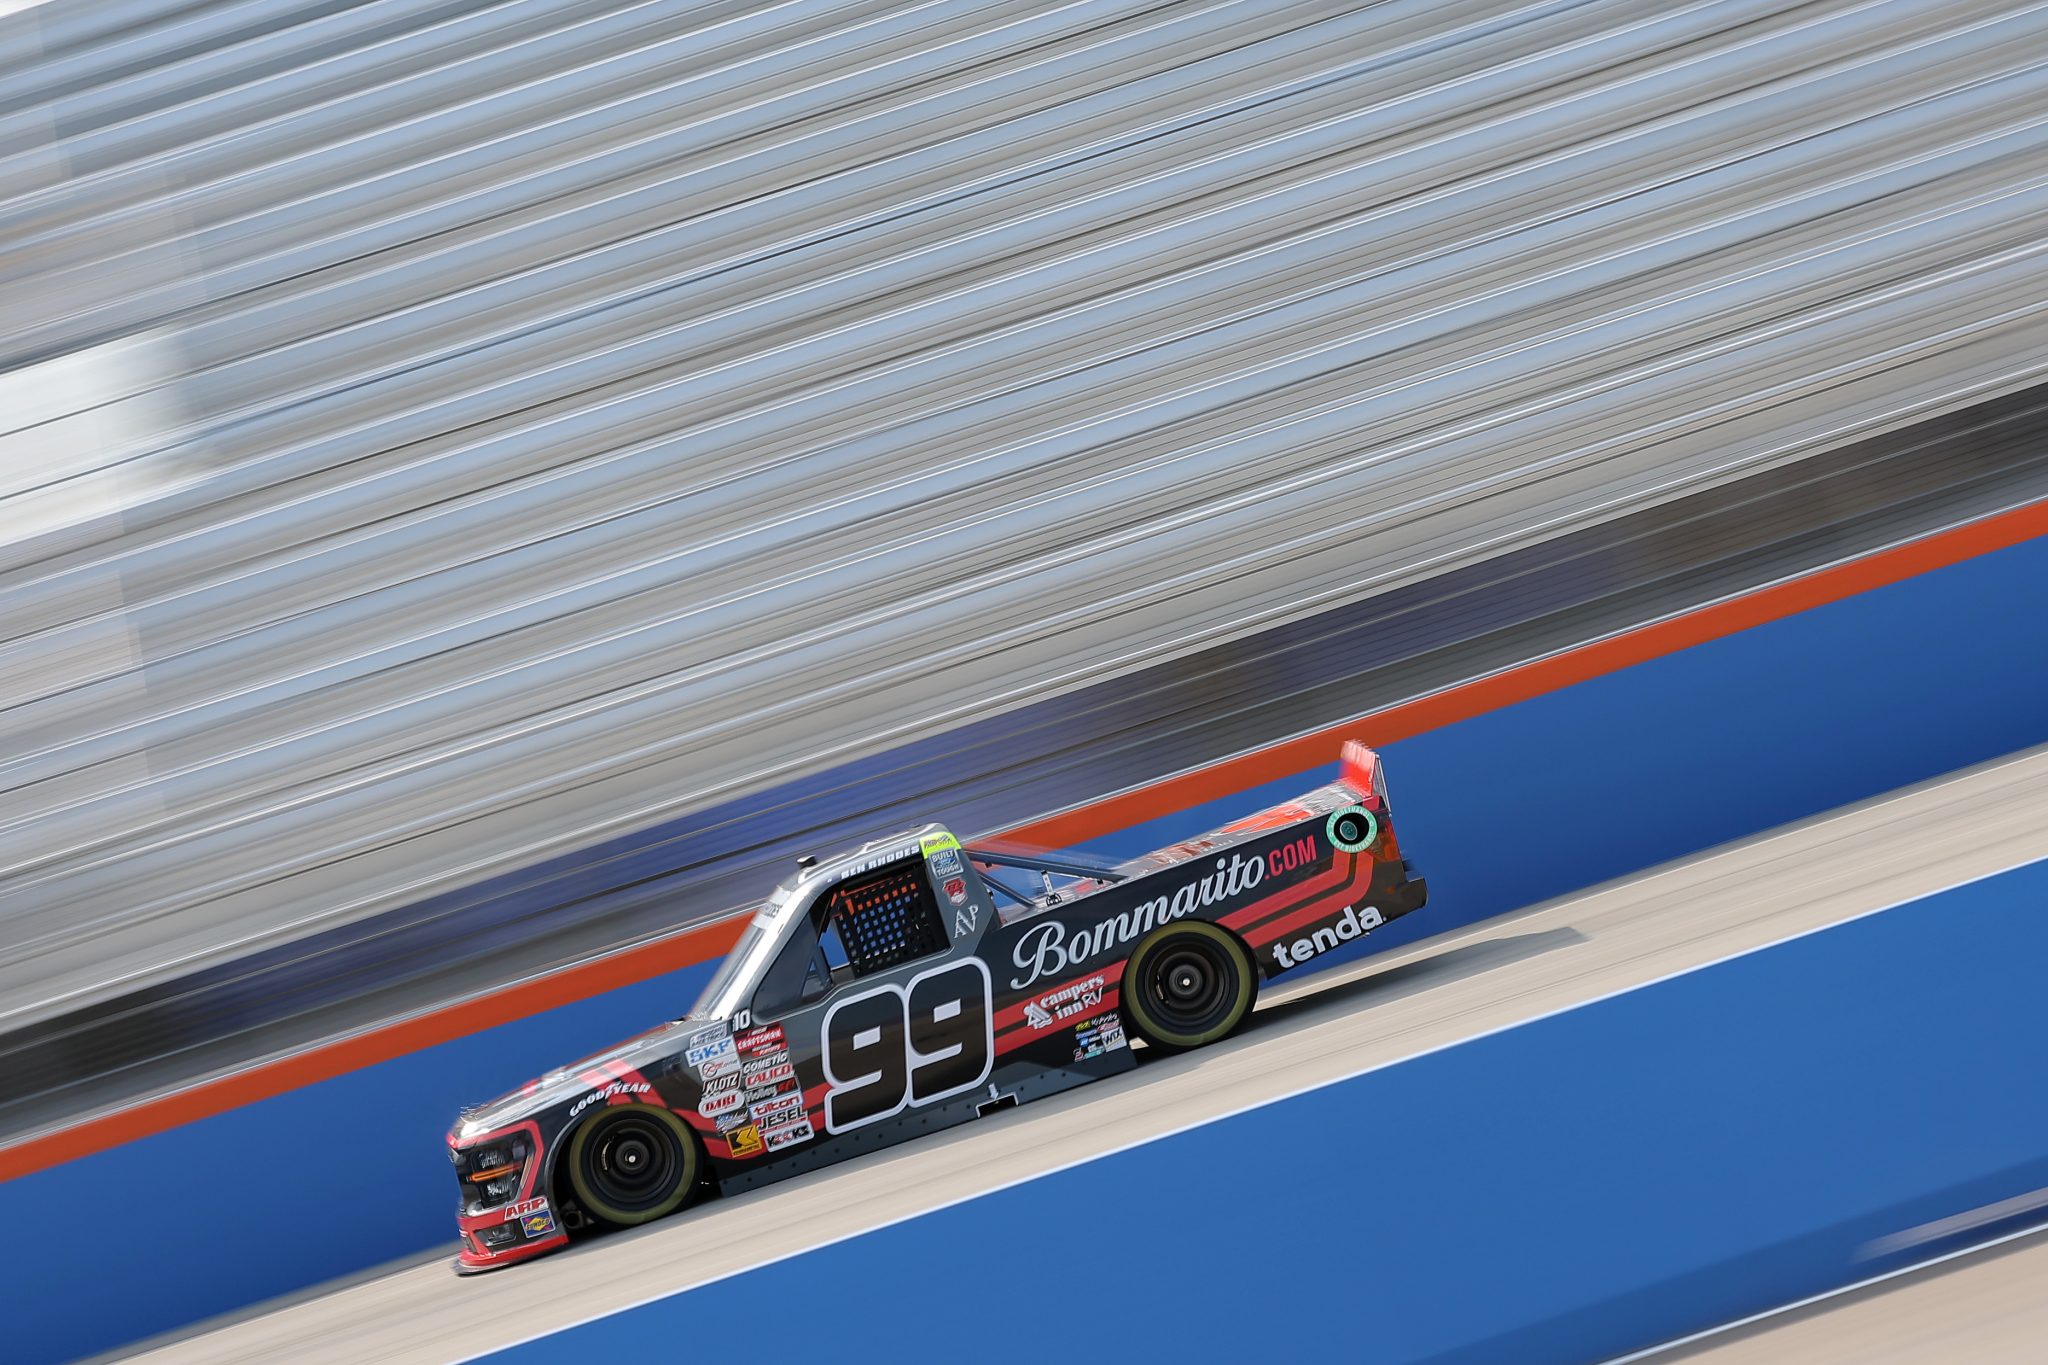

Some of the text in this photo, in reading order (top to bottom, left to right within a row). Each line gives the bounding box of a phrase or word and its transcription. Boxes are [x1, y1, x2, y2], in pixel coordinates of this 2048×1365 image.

[868, 844, 920, 870] RHODES
[931, 850, 955, 863] BUILT
[936, 864, 960, 876] TOUGH
[1040, 975, 1105, 1008] campers
[1054, 1000, 1084, 1020] inn
[1081, 985, 1103, 1008] RV
[732, 1008, 751, 1032] 10
[690, 1039, 732, 1062] SKF
[737, 1029, 781, 1050] CRAFTSMAN
[821, 956, 994, 1136] 99
[743, 1052, 788, 1074] COMETIC
[705, 1074, 739, 1094] KLOTZ
[746, 1065, 791, 1086] CALICO
[569, 1081, 652, 1117] GOODYEAR
[704, 1095, 736, 1112] DART
[744, 1085, 778, 1102] Holley
[753, 1096, 800, 1116] tilton
[758, 1106, 806, 1130] JESEL
[766, 1125, 810, 1148] KOOKS
[506, 1198, 547, 1220] ARP
[526, 1218, 551, 1231] SUNOCO
